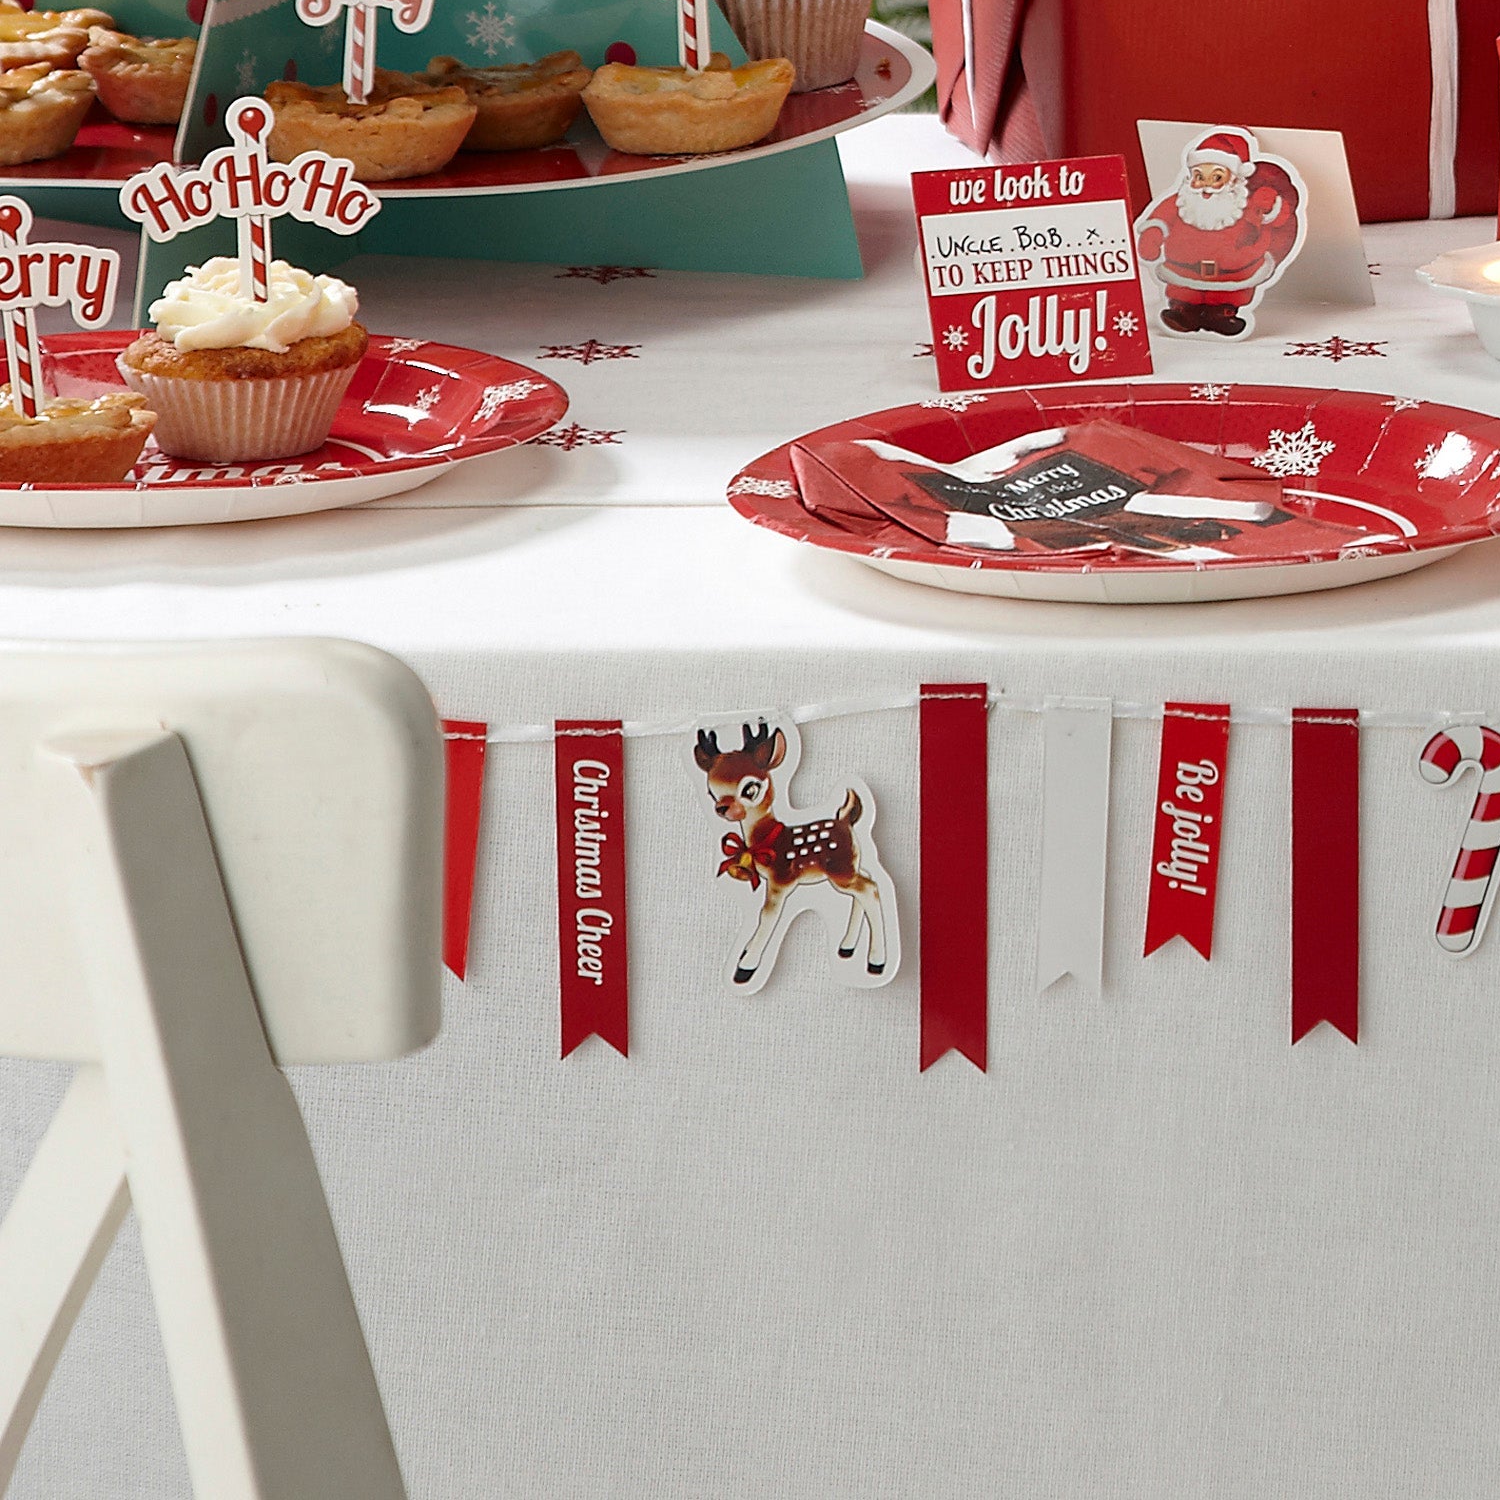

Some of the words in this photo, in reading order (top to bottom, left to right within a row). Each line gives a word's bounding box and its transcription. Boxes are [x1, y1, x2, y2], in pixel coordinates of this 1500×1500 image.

[950, 178, 986, 206] we
[994, 165, 1053, 202] look
[1058, 165, 1086, 196] to
[933, 264, 964, 288] TO
[972, 258, 1033, 285] KEEP
[1040, 250, 1129, 279] THINGS
[936, 235, 1003, 258] UNCLE
[1012, 225, 1063, 251] BOB
[0, 253, 111, 321] erry
[967, 289, 1108, 379] Jolly!
[1004, 463, 1080, 495] Merry
[1175, 759, 1219, 803] Be
[572, 759, 610, 899] Christmas
[1156, 801, 1214, 896] jolly!
[575, 907, 613, 986] Cheer
